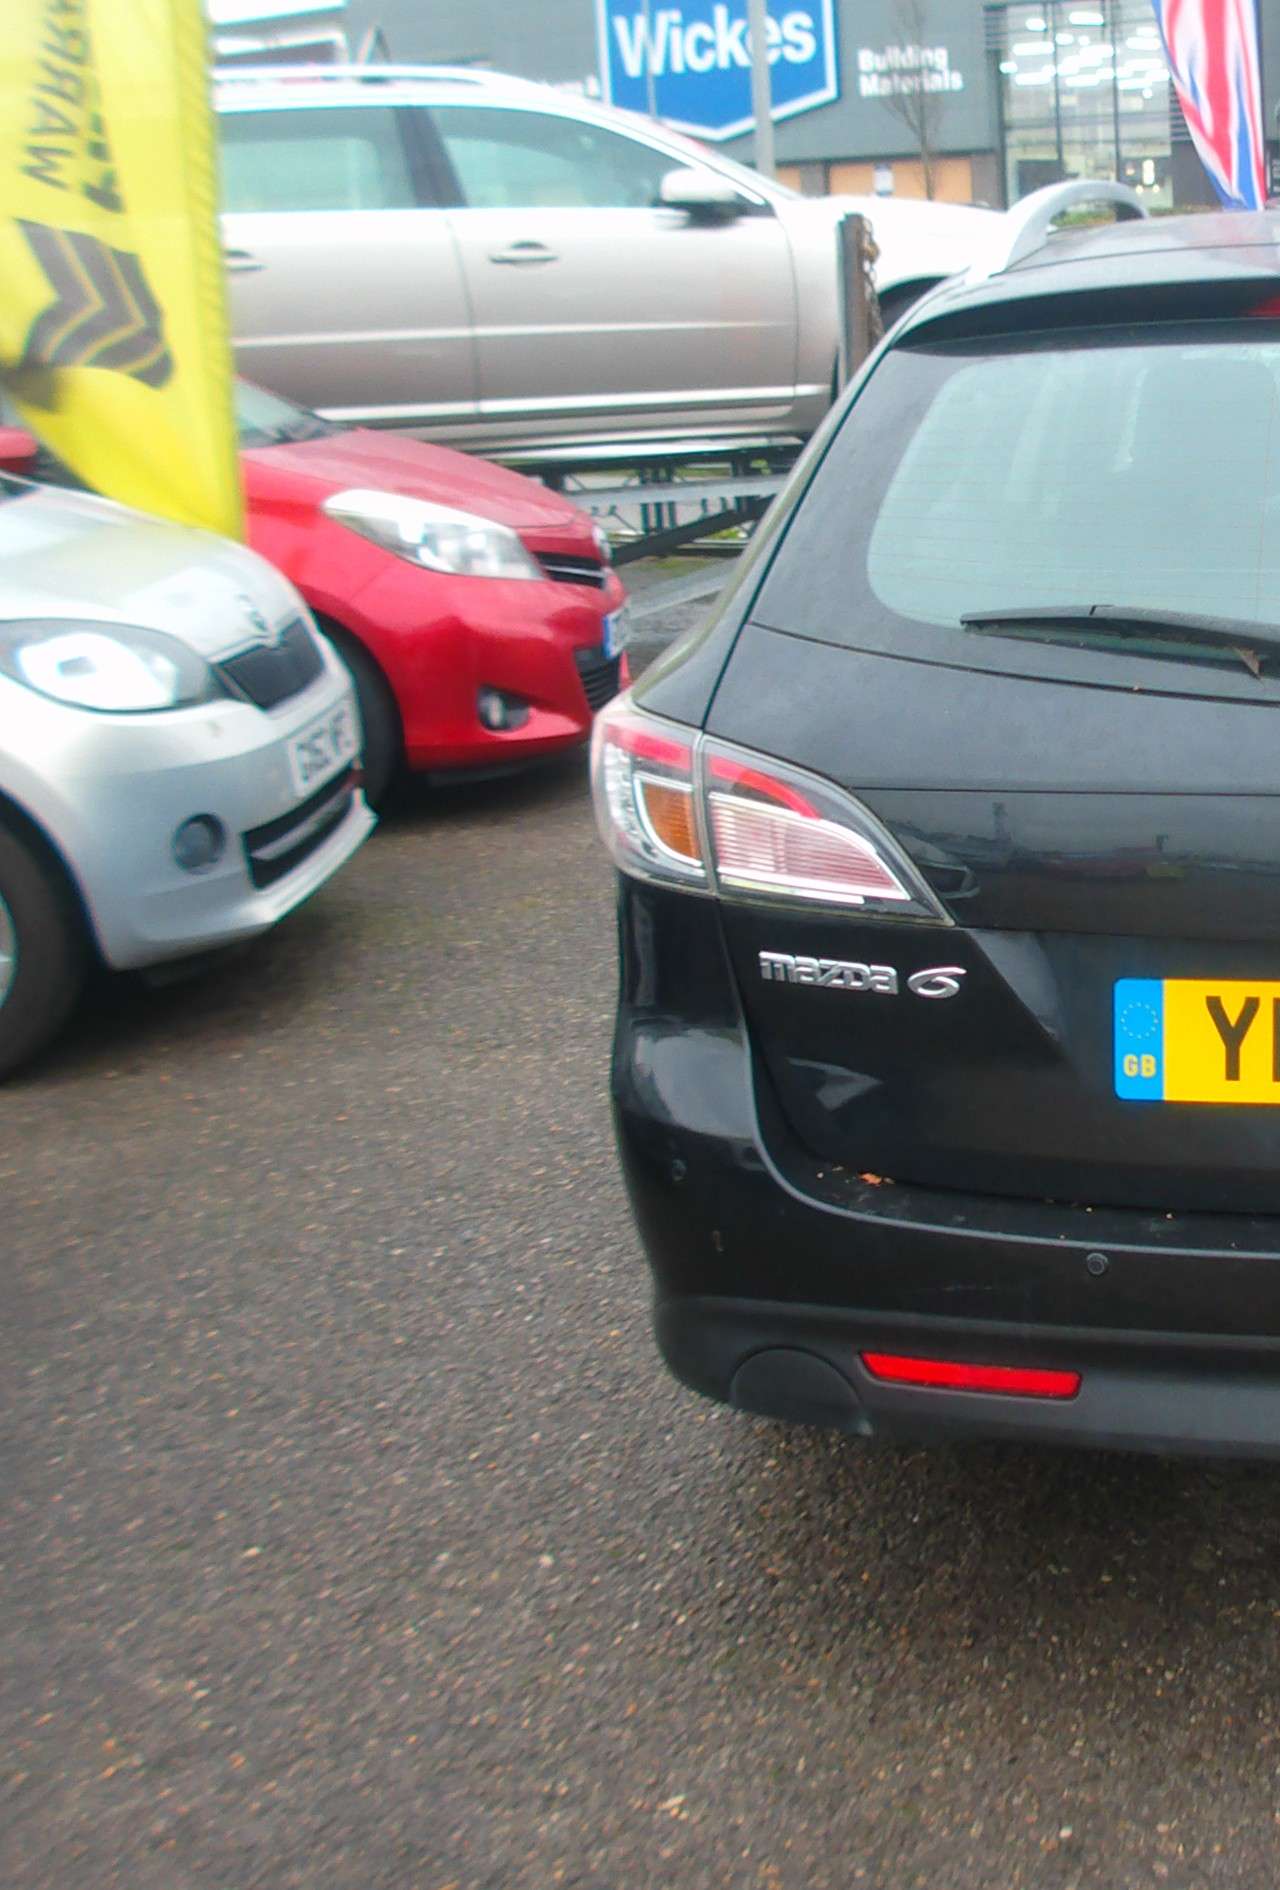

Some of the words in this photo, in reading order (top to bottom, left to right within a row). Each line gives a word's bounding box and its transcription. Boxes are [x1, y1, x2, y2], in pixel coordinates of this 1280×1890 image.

[613, 3, 817, 78] Wickes
[758, 950, 899, 995] mazda
[907, 965, 967, 999] 6
[1123, 1054, 1157, 1078] GB
